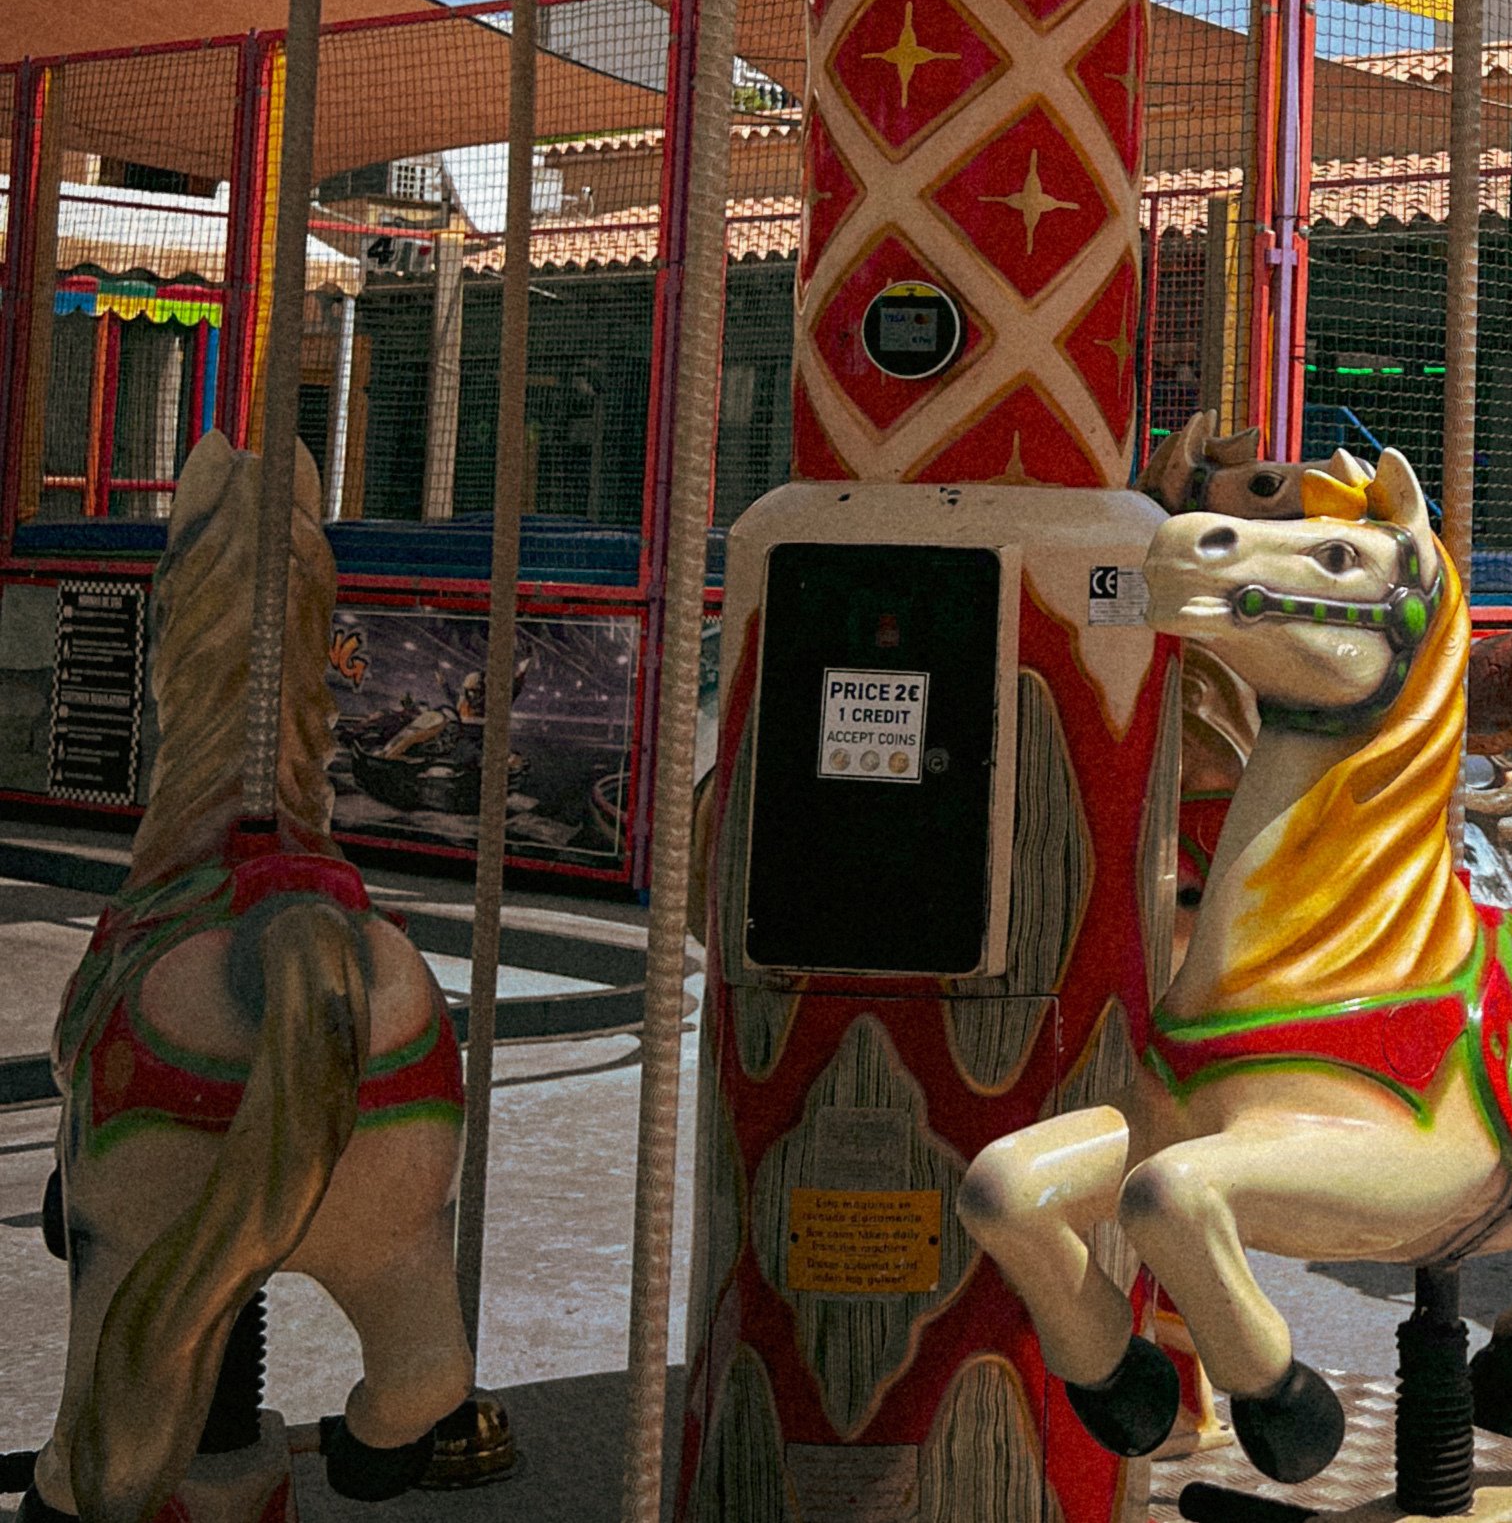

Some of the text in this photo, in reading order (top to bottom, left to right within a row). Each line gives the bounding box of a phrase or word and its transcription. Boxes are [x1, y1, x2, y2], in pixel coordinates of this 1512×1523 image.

[829, 681, 920, 702] PRICE 2€
[838, 707, 911, 725] 1 CREDIT
[826, 730, 917, 746] ACCEPT COINS
